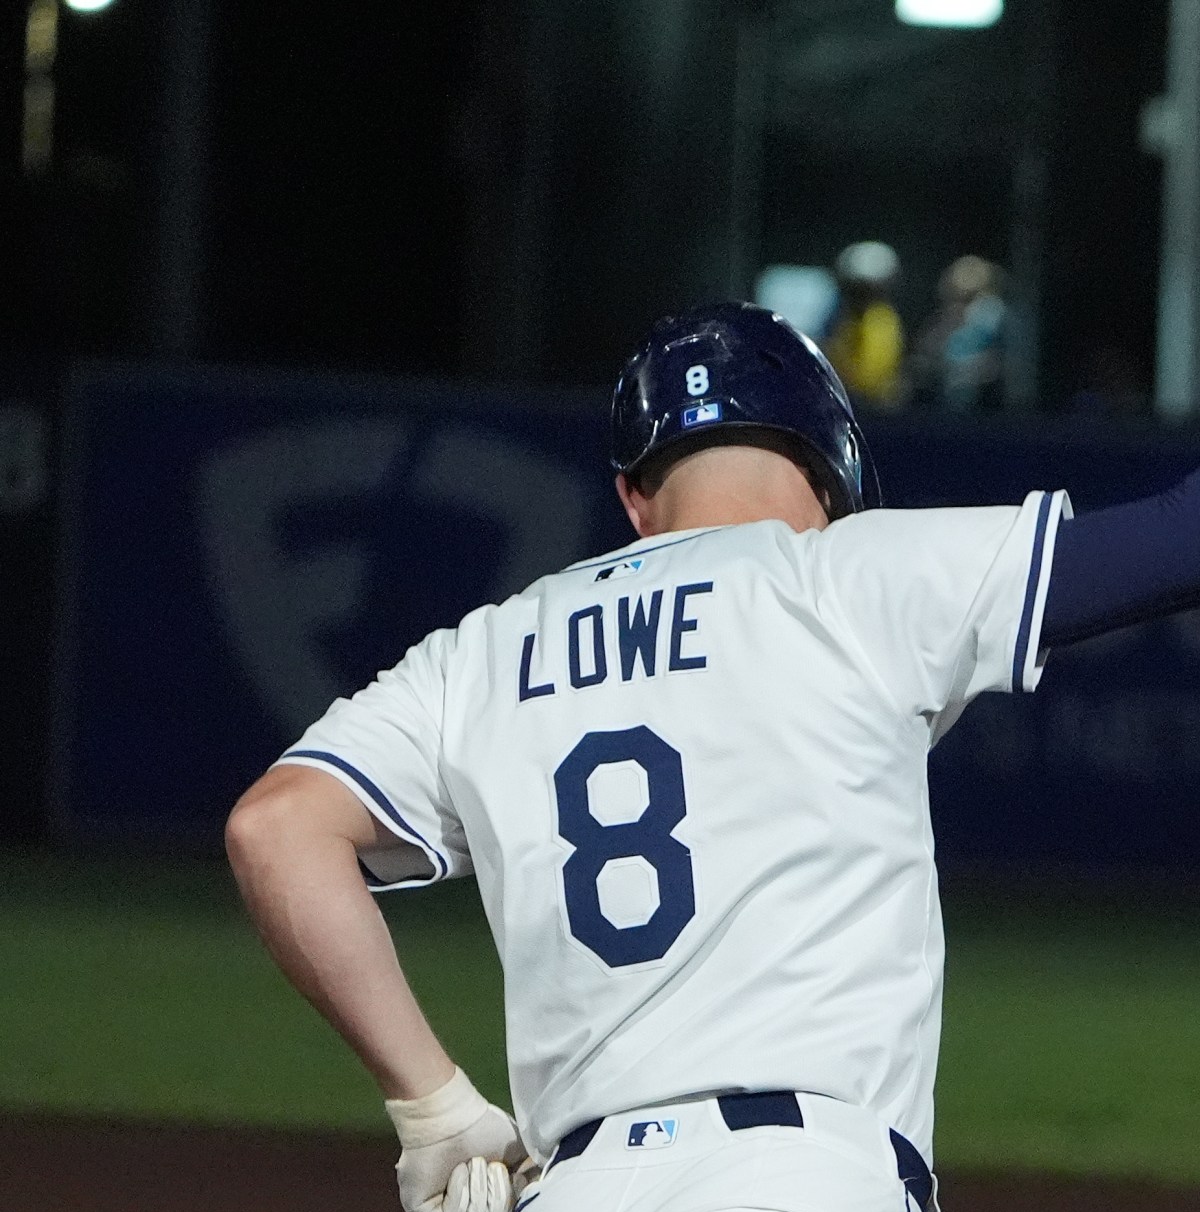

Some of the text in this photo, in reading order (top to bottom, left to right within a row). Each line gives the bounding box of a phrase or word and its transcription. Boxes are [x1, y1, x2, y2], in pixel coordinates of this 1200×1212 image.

[685, 364, 710, 397] 8
[519, 581, 714, 702] LOWE
[553, 724, 697, 969] 8
